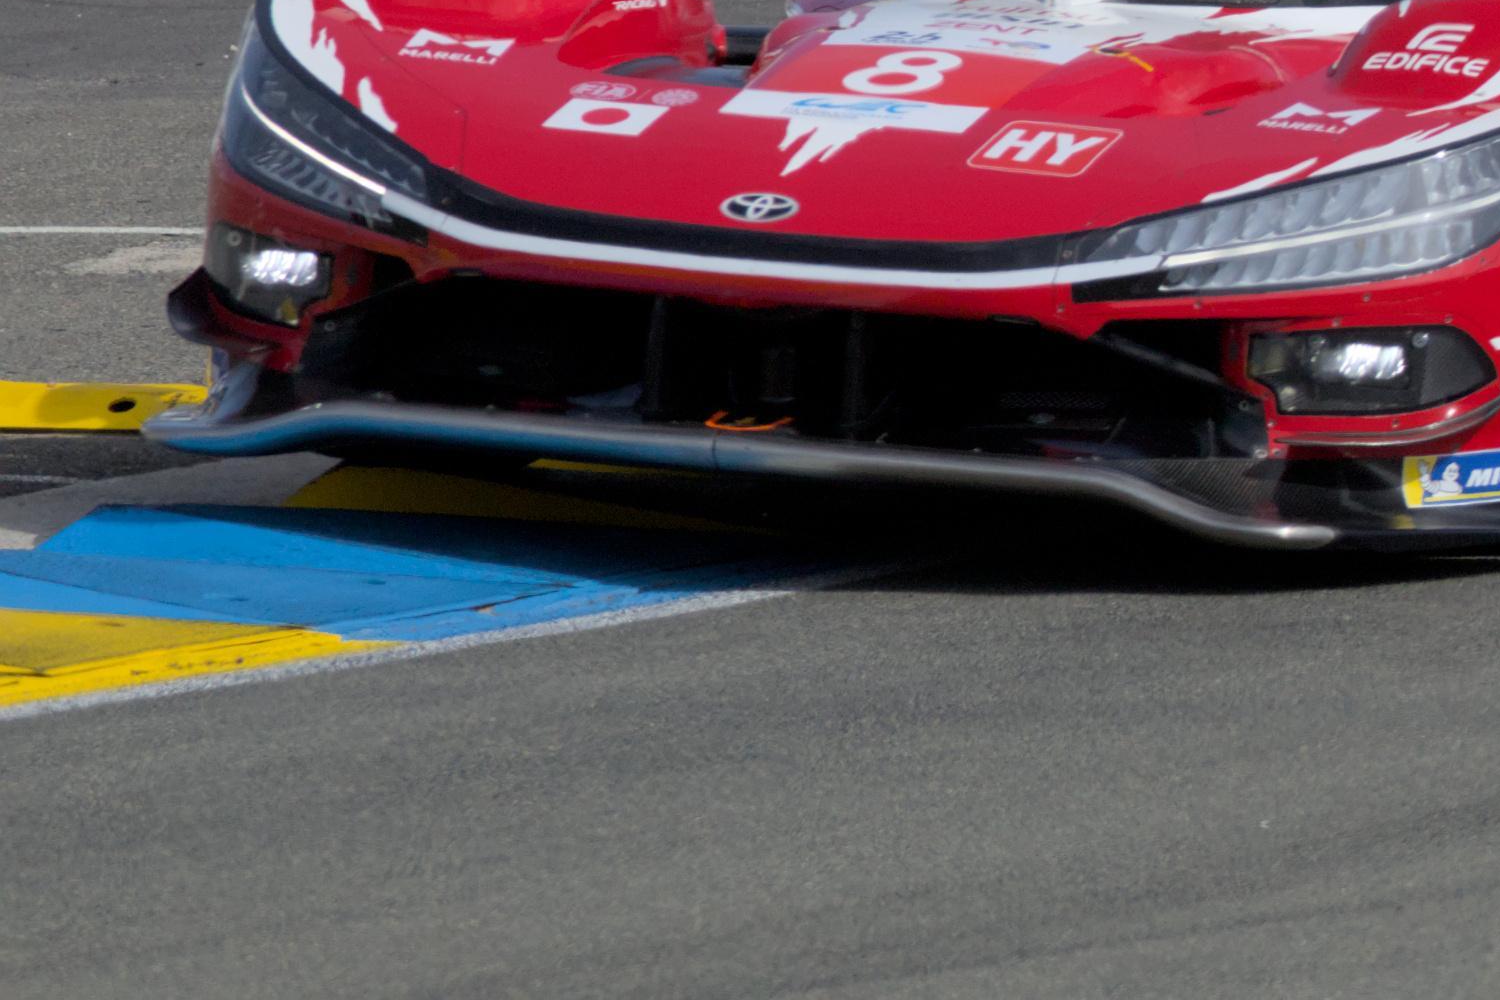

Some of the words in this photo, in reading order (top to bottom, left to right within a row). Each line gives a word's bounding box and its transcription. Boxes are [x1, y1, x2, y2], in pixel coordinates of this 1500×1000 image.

[397, 47, 499, 66] MARELLI
[1362, 51, 1490, 78] EDIFICE
[841, 50, 964, 95] 8
[1257, 118, 1349, 135] MARELLI
[984, 127, 1108, 168] HY
